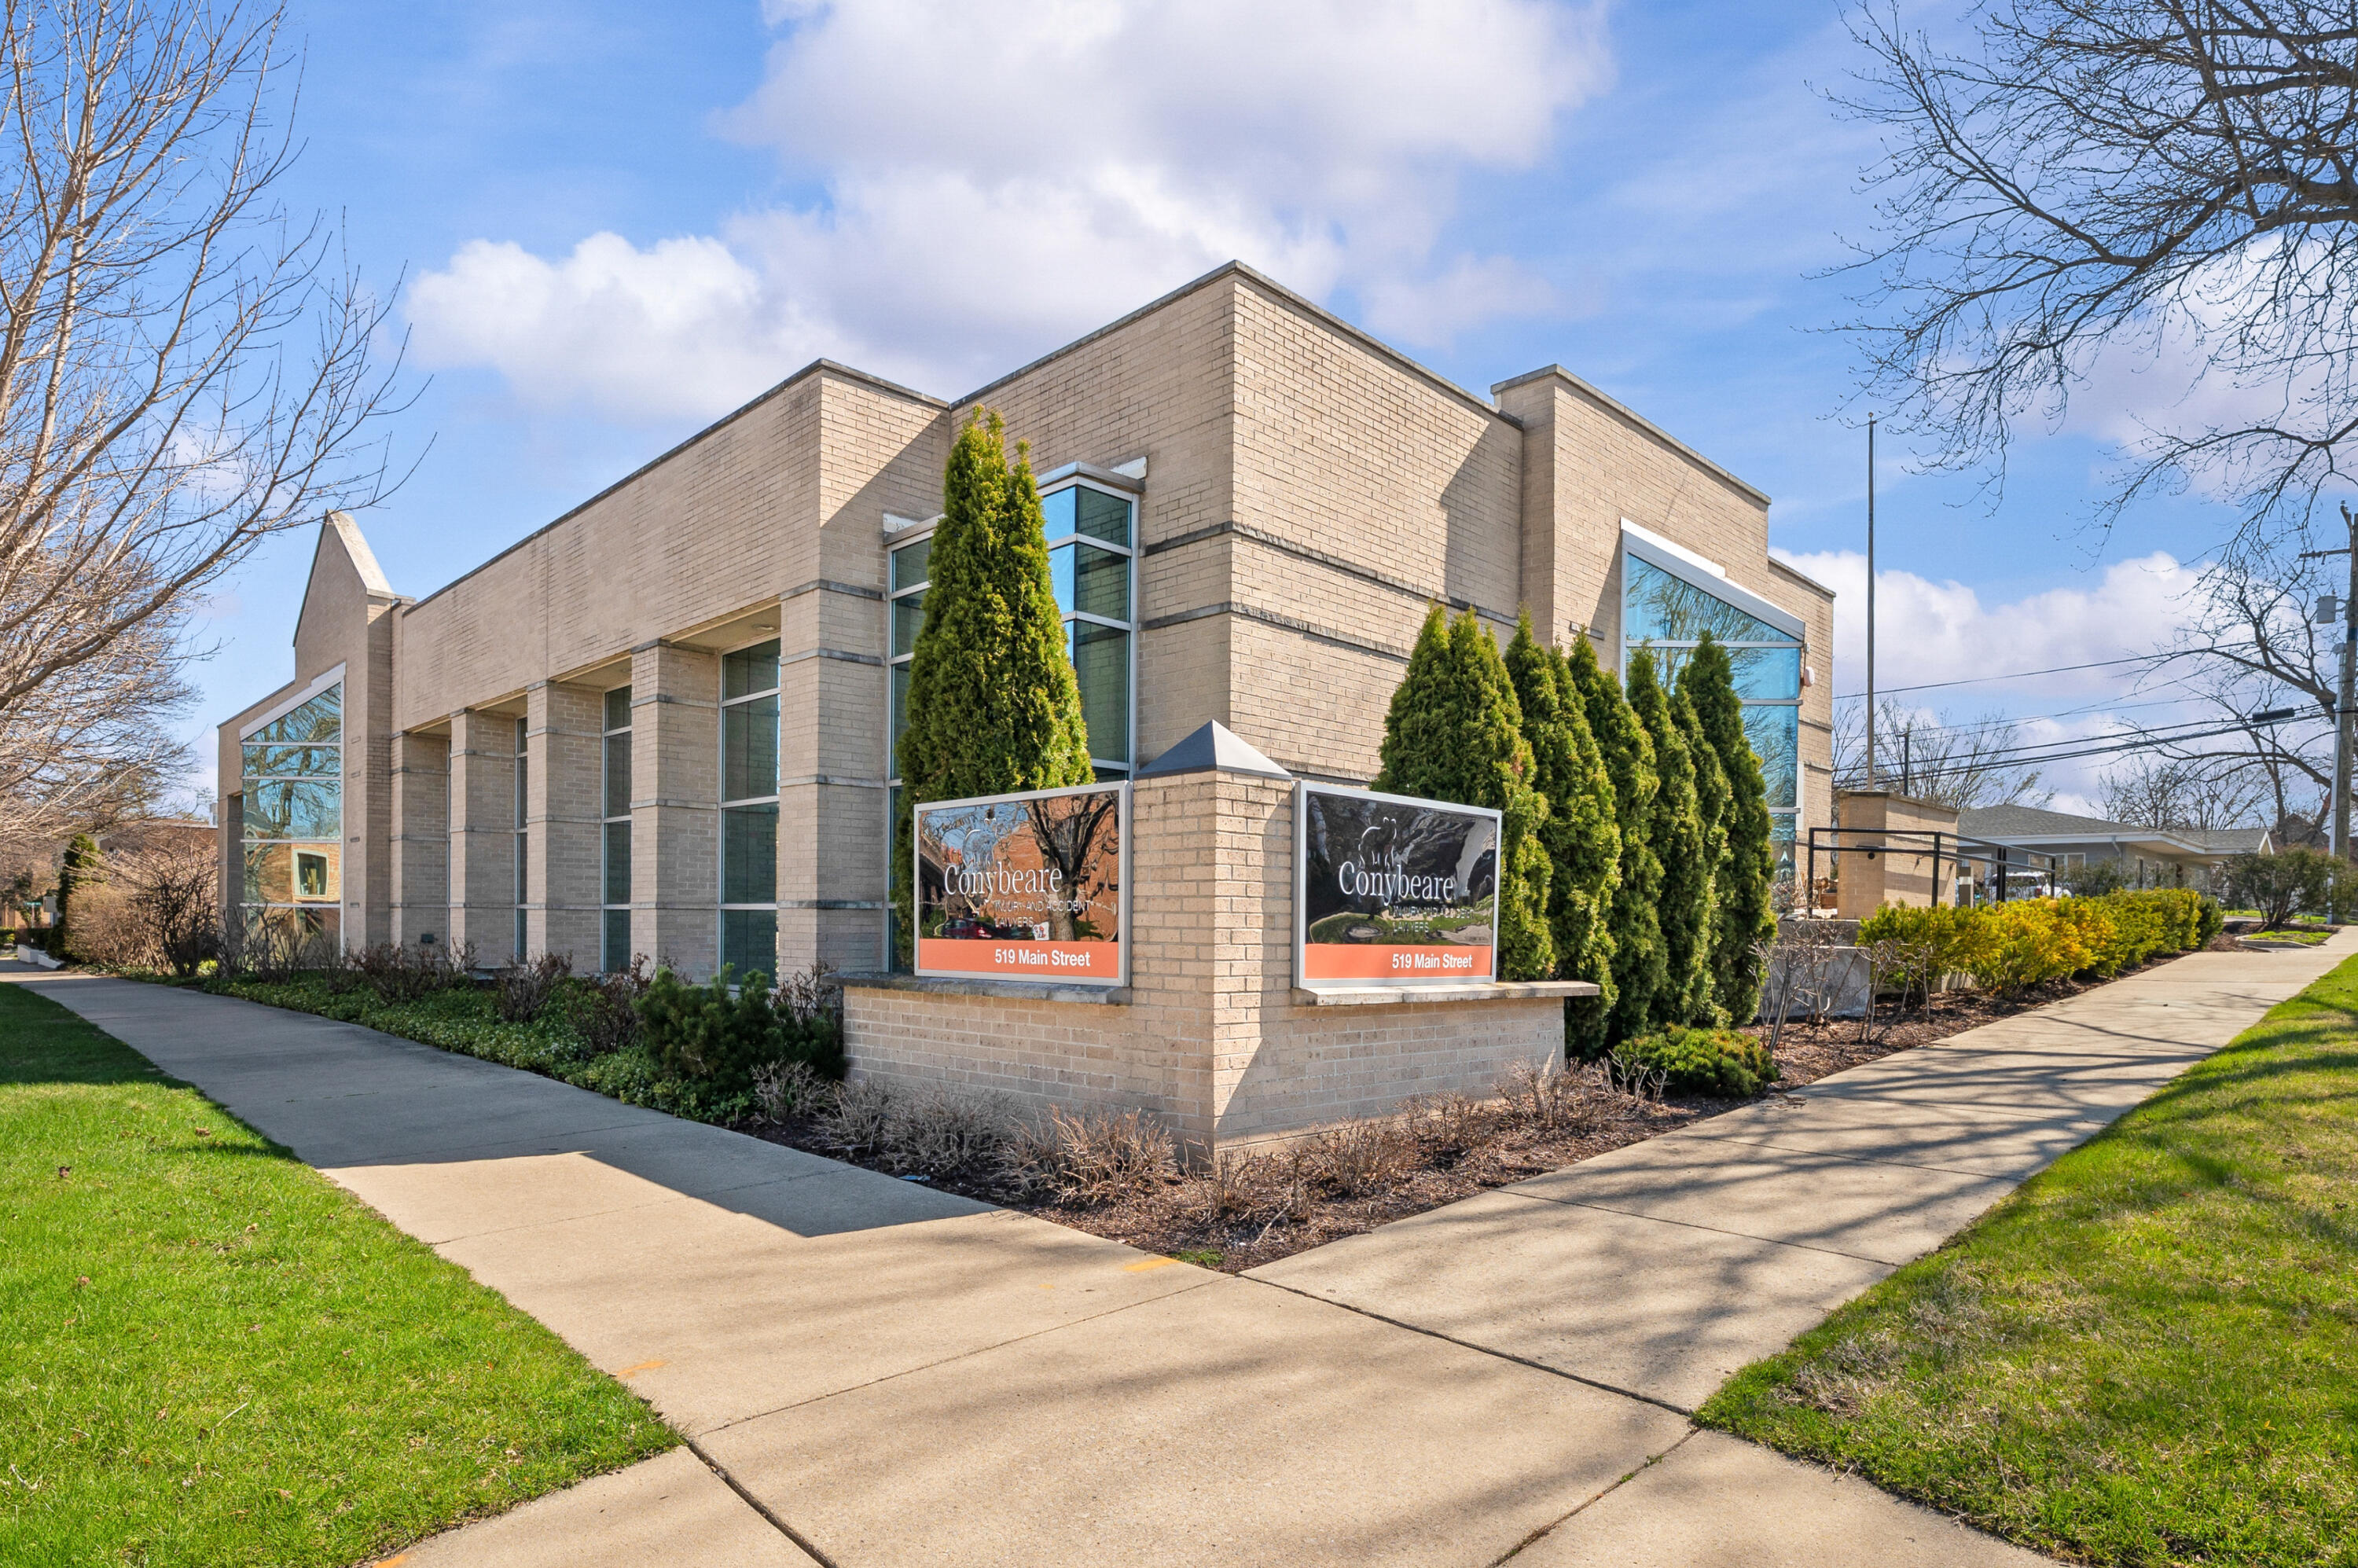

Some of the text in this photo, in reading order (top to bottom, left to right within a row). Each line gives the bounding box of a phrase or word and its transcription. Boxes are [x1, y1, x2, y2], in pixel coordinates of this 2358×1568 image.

[944, 861, 1063, 903] Conybeare
[1339, 861, 1453, 906] Conybeare
[995, 900, 1090, 912] INJURY AND ACCIDENT
[994, 916, 1034, 927] LAWYERS
[994, 949, 1090, 967] 519 Main Street
[1392, 953, 1472, 968] 519 Main Street
